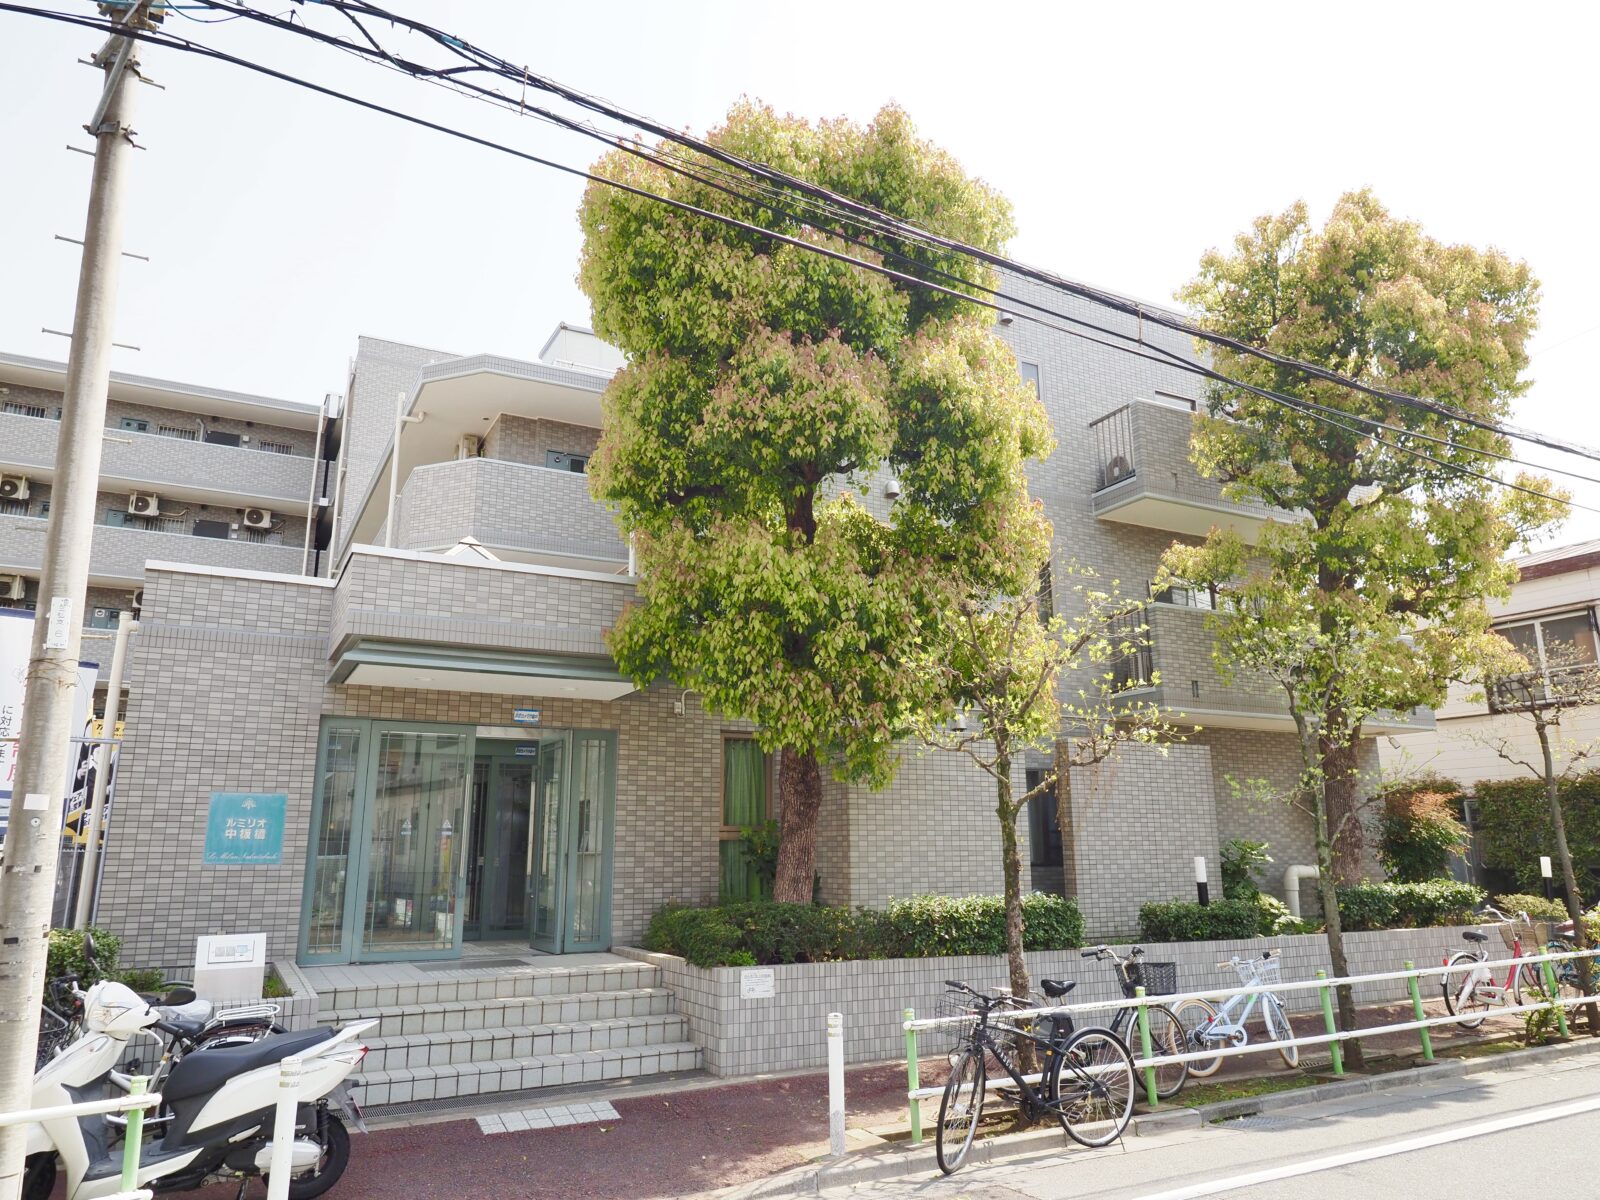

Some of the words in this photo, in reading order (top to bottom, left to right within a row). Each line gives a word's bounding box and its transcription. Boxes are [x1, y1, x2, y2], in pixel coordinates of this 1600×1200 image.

[226, 818, 267, 828] ルミリオ
[225, 829, 266, 839] 中板橋
